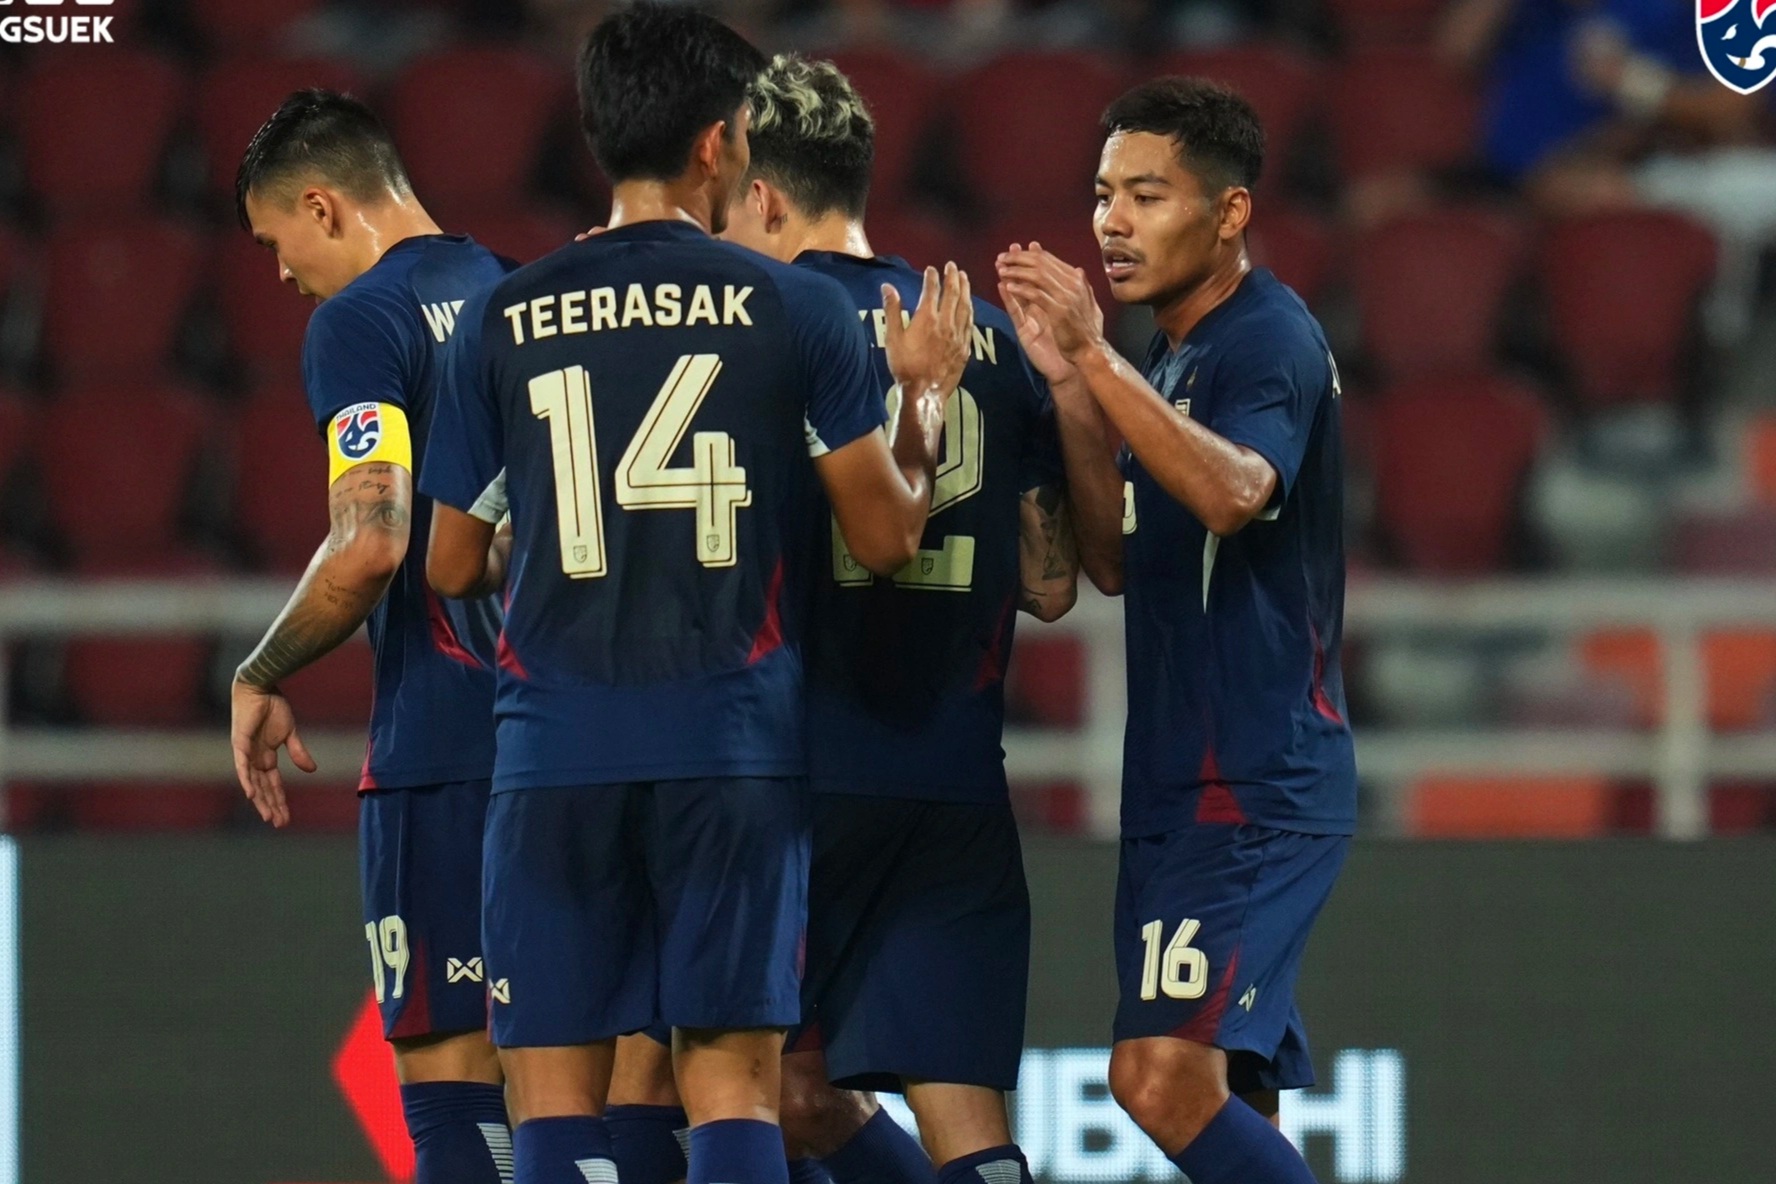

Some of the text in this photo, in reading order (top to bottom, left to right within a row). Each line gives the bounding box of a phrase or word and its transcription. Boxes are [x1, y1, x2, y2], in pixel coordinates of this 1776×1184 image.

[503, 283, 754, 345] TEERASAK
[528, 353, 752, 579] 14
[365, 914, 410, 1004] 19
[1140, 918, 1209, 1001] 16
